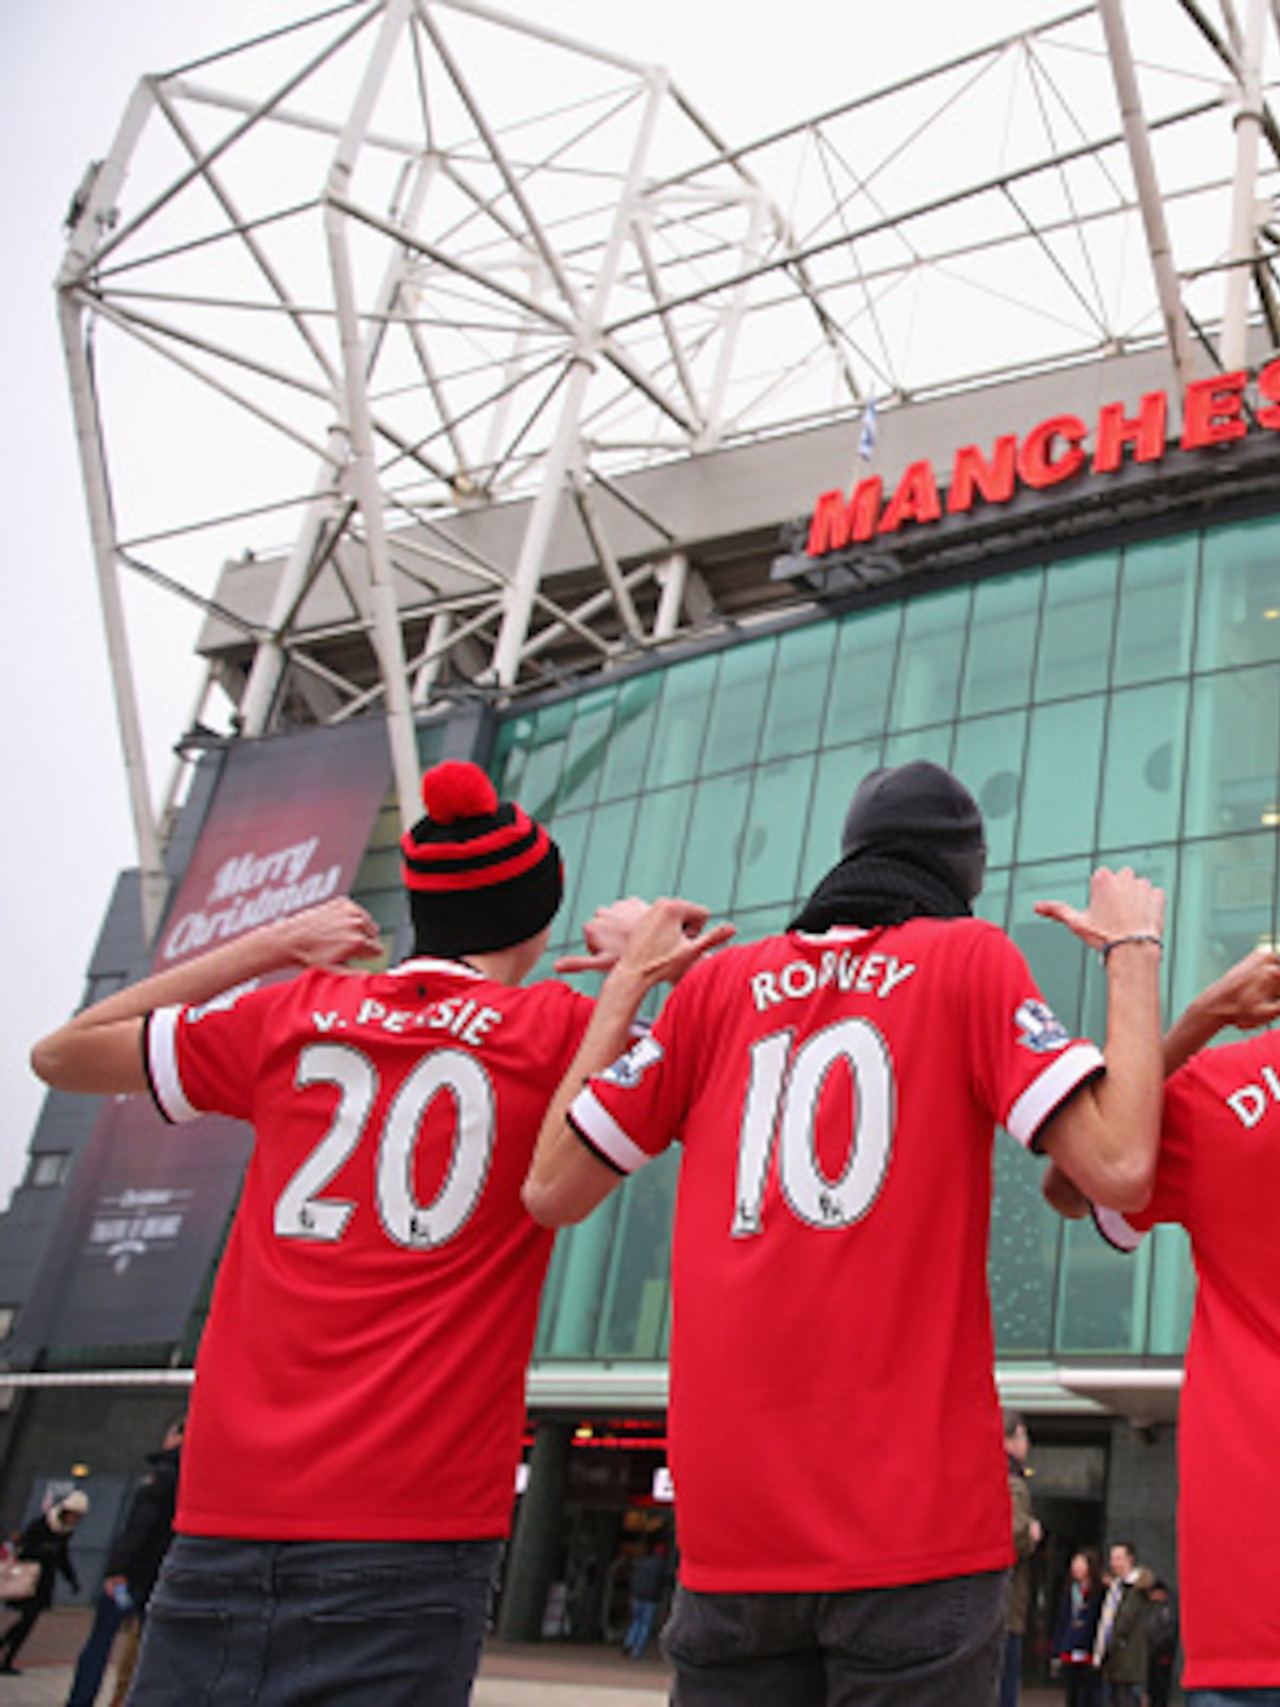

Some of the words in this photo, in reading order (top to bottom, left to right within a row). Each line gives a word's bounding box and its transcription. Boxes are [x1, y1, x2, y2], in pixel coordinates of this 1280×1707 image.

[207, 836, 320, 905] Merry
[273, 1042, 496, 1249] 20
[731, 1017, 895, 1236] 10
